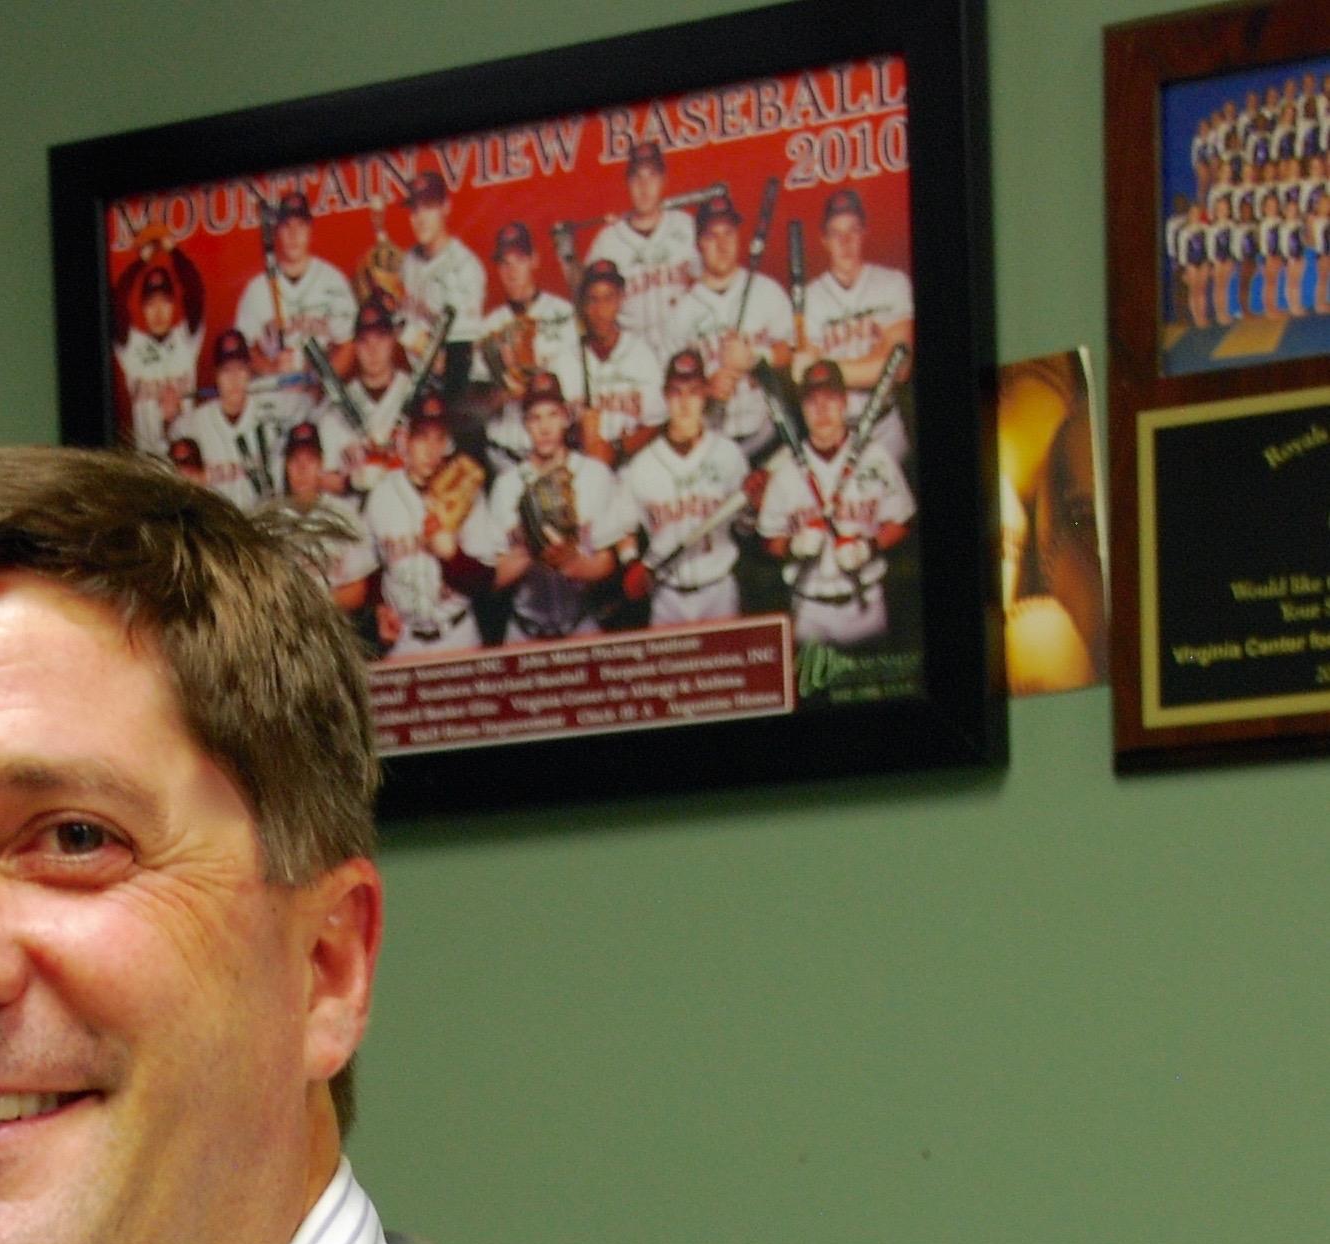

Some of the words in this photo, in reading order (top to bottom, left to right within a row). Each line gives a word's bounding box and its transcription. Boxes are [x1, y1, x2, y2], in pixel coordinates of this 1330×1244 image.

[110, 148, 419, 252] MOUNTAIN
[433, 113, 581, 192] VIEW
[598, 60, 907, 165] BASEBALL
[784, 116, 908, 191] 2010
[1172, 642, 1244, 667] Virginia
[1245, 636, 1307, 658] Center
